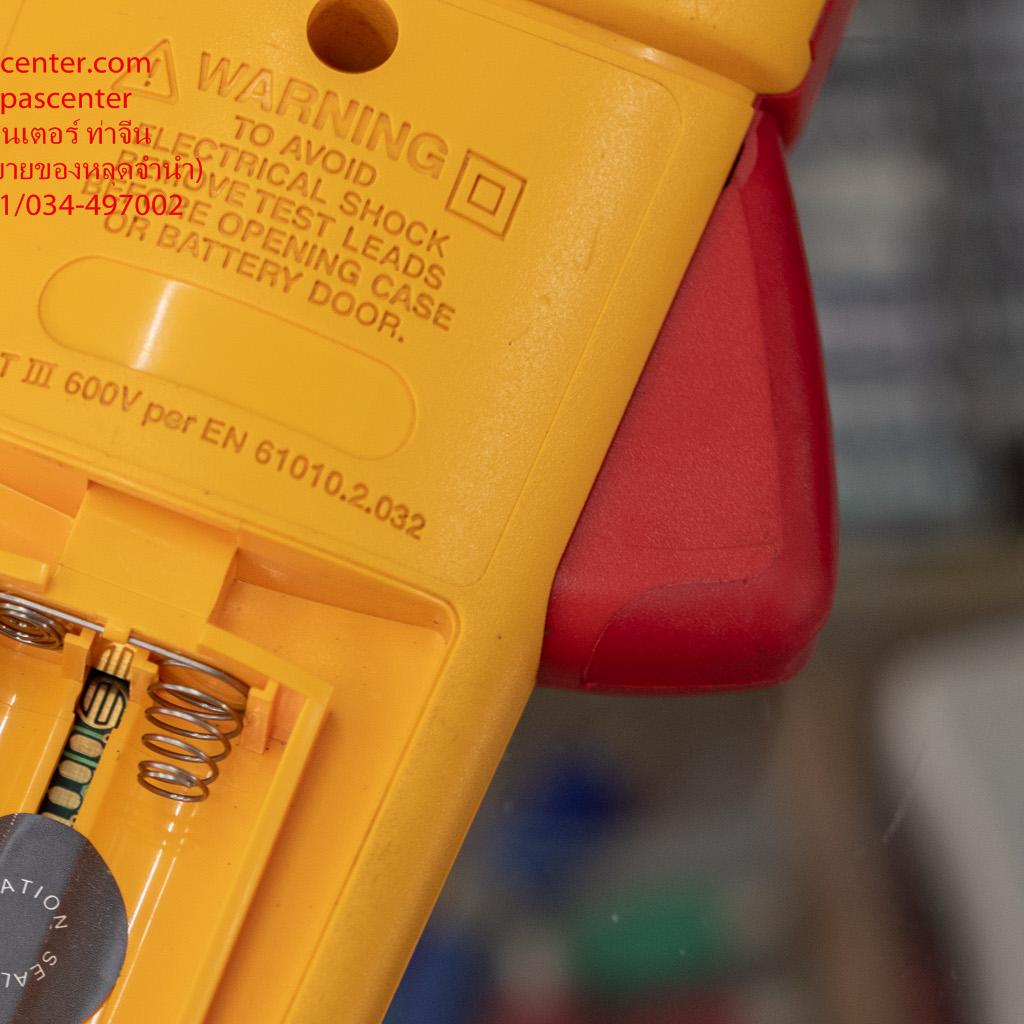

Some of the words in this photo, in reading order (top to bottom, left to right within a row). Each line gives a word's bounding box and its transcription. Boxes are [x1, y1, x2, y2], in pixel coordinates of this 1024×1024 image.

[197, 52, 449, 179] WARNING
[235, 115, 274, 147] TO
[280, 135, 377, 188] AVOID
[81, 170, 212, 226] BEFORE
[217, 212, 362, 287] OPENING
[370, 273, 456, 332] CASE
[113, 149, 248, 209] REMOVE
[256, 189, 336, 238] TEST
[342, 227, 446, 291] LEADS
[131, 121, 327, 205] ELECTRICAL
[339, 190, 451, 258] SHOCK
[103, 210, 151, 242] OR
[157, 223, 304, 294] BATTERY
[307, 280, 404, 344] DOOR.
[20, 357, 58, 389] III
[64, 371, 144, 413] 600V
[140, 400, 197, 434] per
[200, 417, 248, 454] EN
[254, 440, 427, 541] 61010.2.032
[1, 951, 57, 988] SEAL
